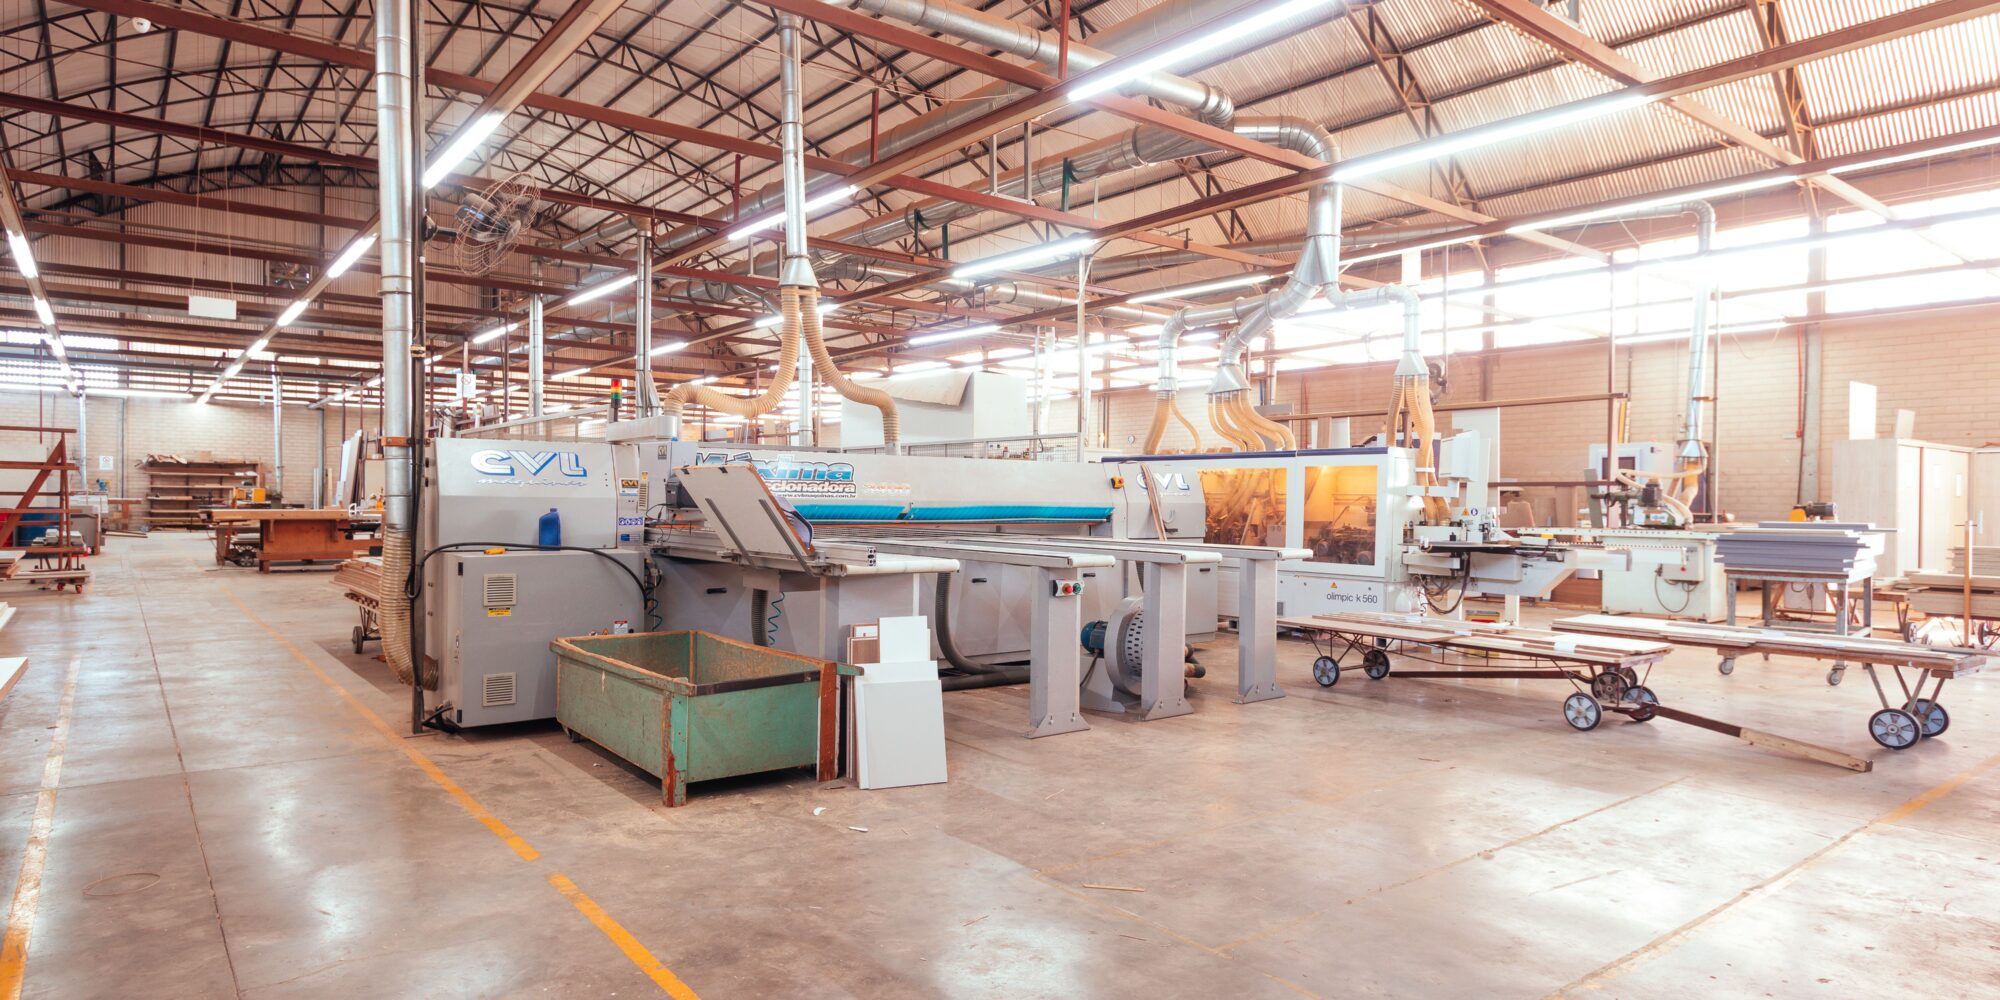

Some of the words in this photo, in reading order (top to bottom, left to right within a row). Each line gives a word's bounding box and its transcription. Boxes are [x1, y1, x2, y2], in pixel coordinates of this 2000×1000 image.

[471, 449, 587, 477] CVL
[1326, 591, 1354, 603] olimpic
[1362, 594, 1378, 604] 560
